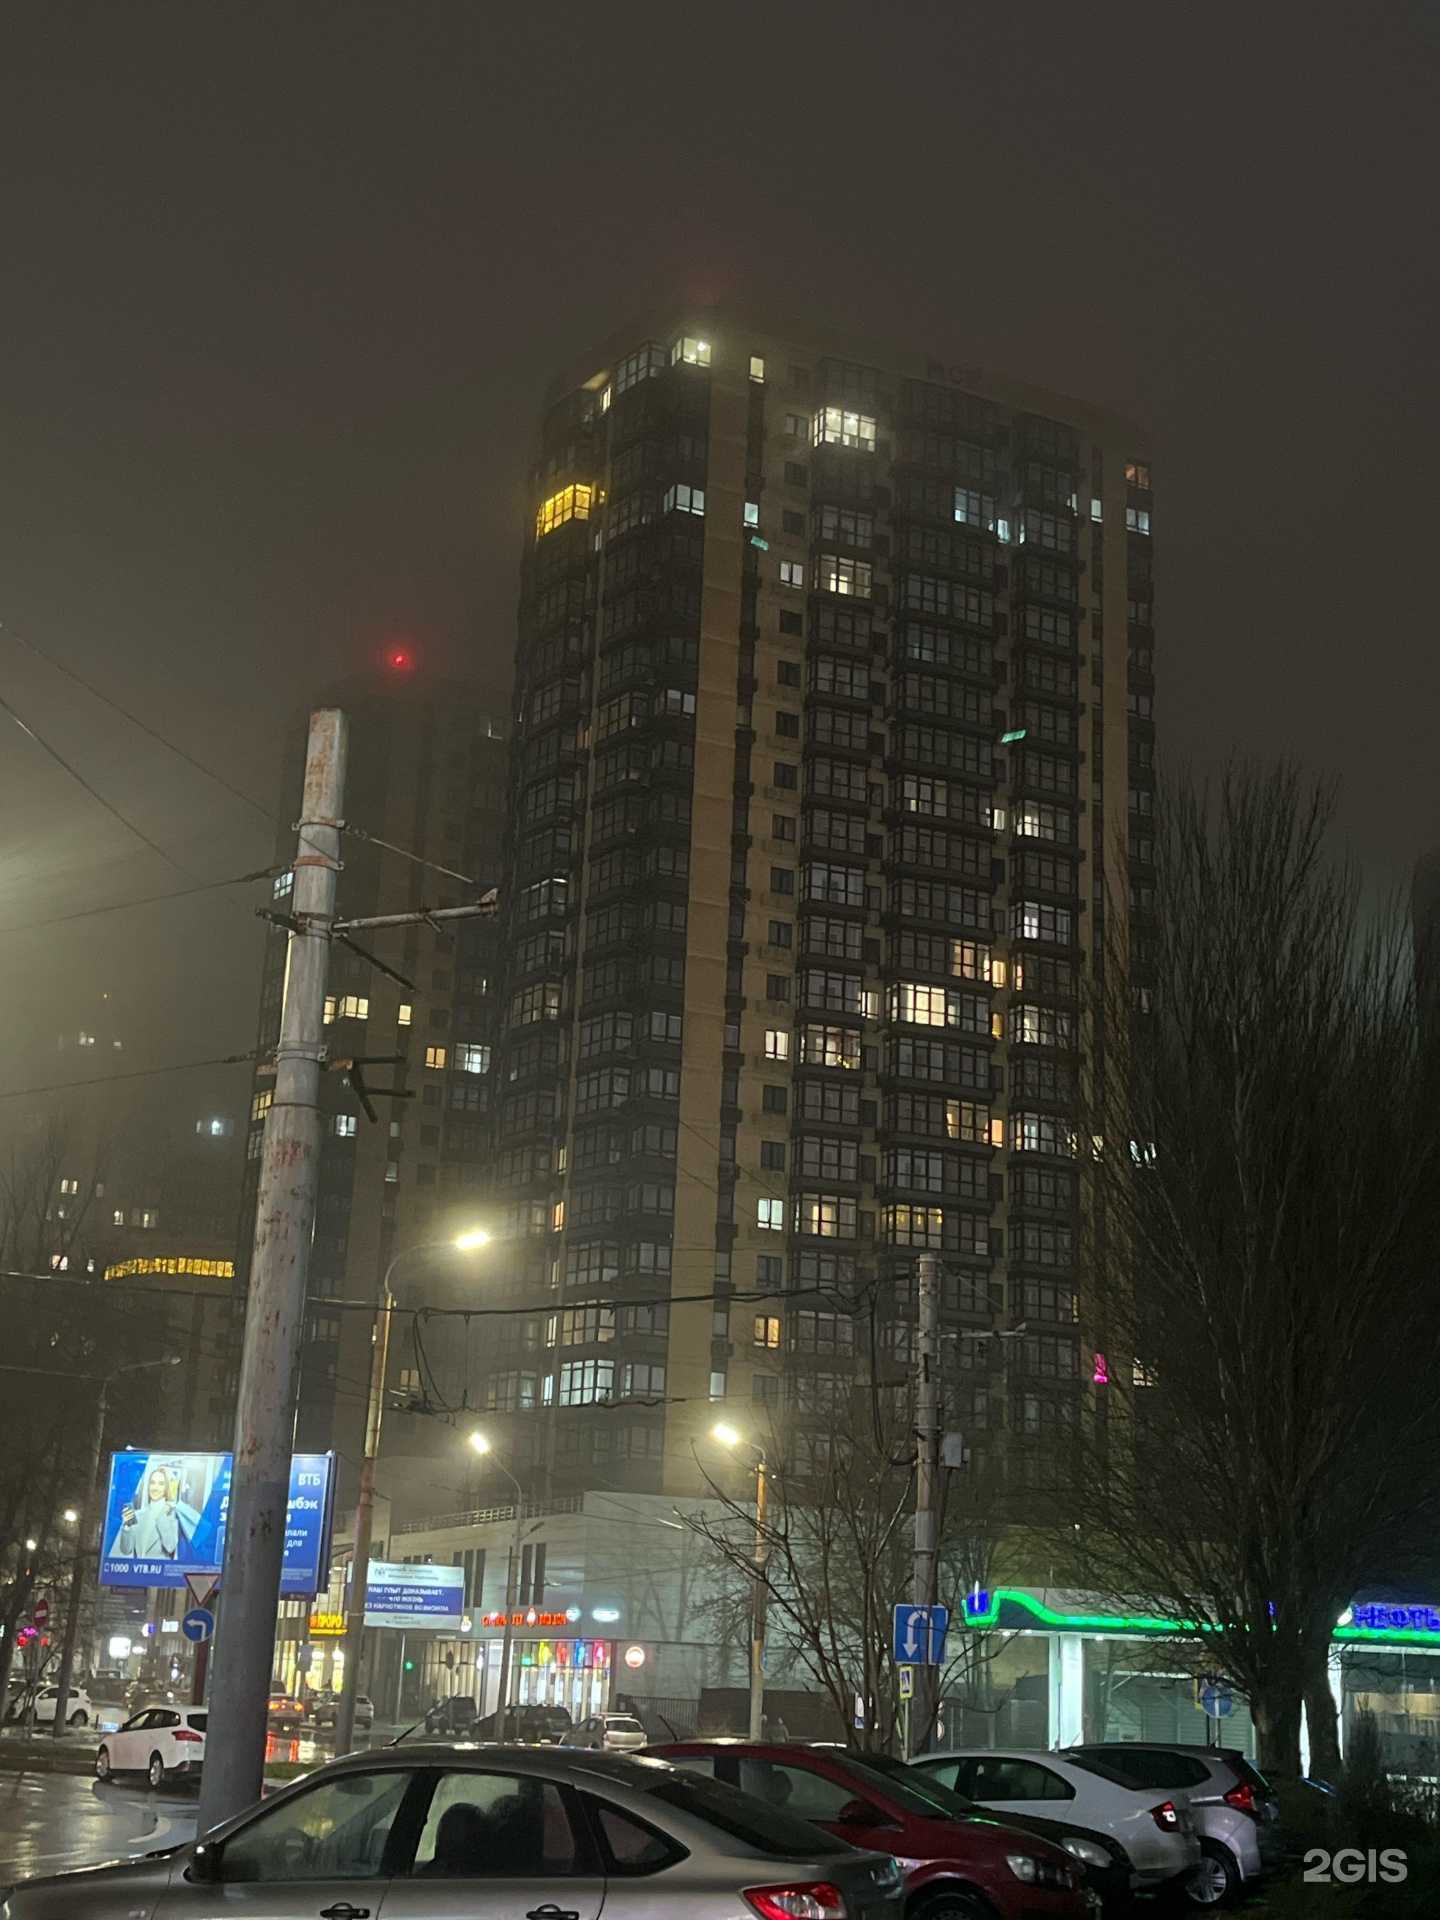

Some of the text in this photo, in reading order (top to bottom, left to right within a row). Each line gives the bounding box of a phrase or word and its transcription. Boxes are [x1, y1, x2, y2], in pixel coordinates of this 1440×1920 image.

[298, 1473, 321, 1486] ВТБ
[111, 1563, 129, 1573] 1000
[134, 1564, 161, 1574] VTB.RU
